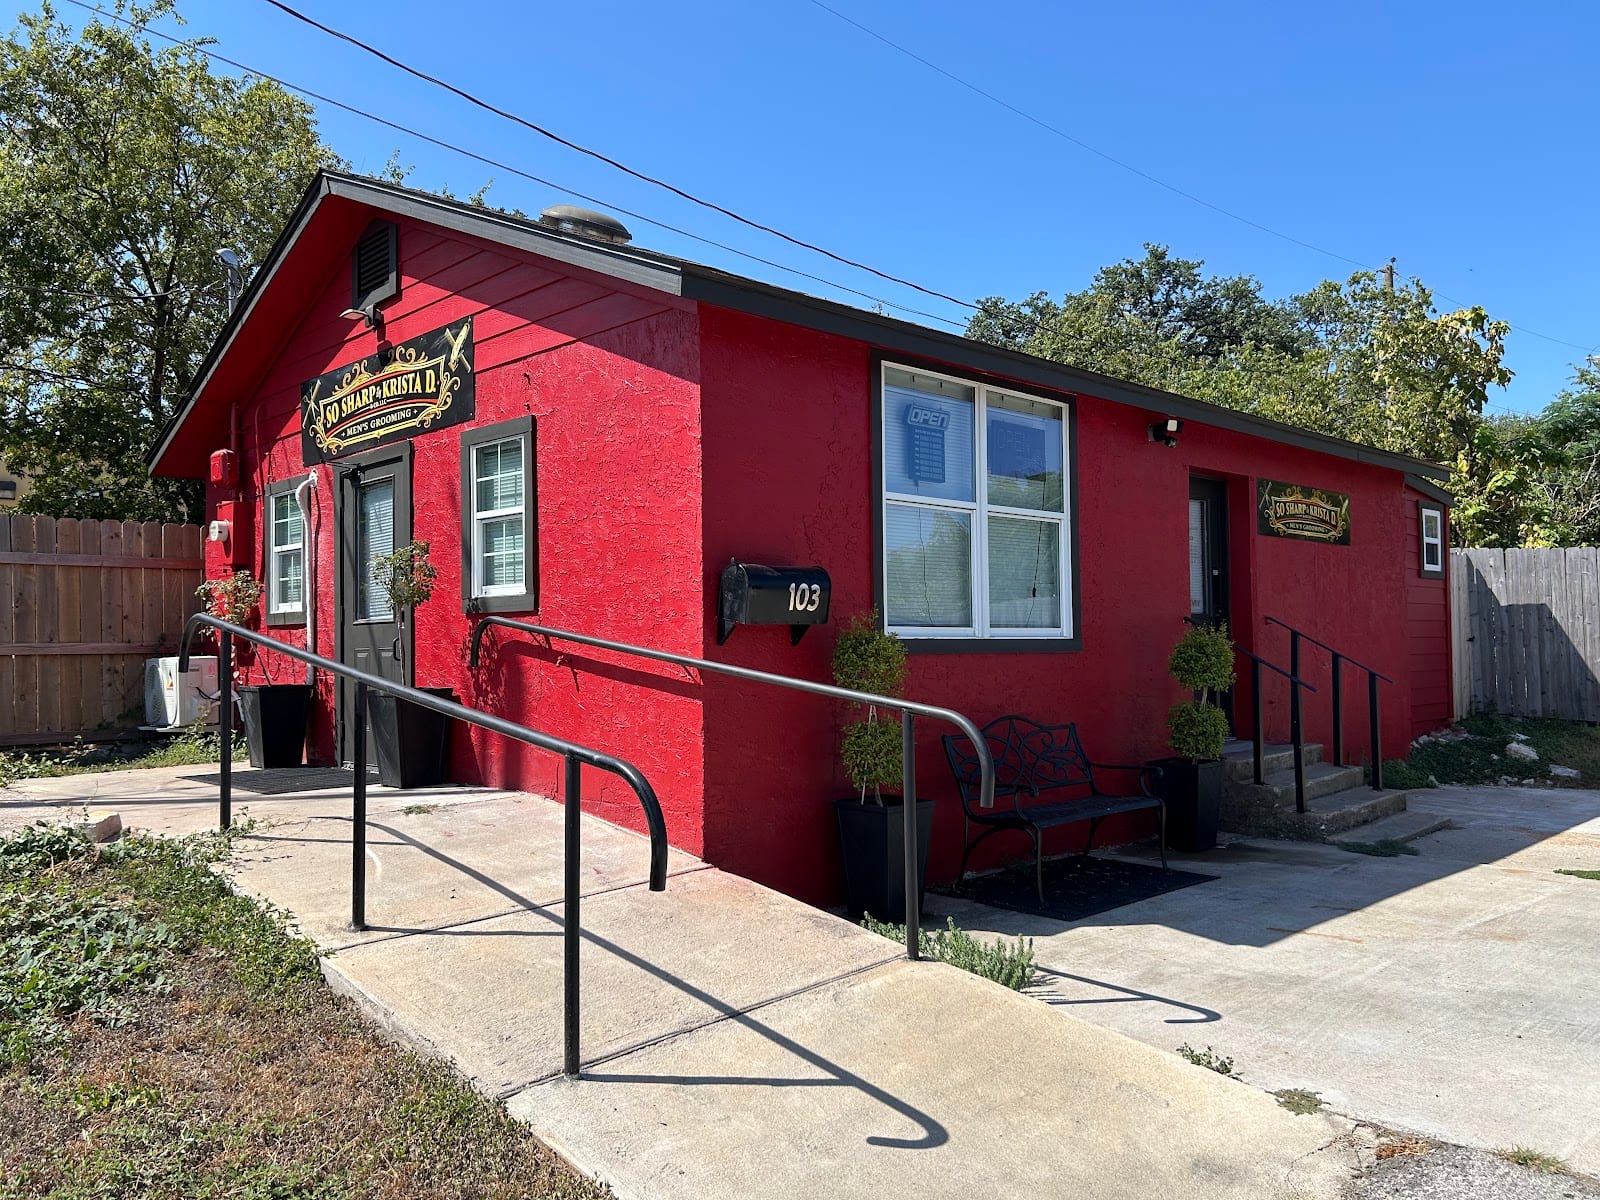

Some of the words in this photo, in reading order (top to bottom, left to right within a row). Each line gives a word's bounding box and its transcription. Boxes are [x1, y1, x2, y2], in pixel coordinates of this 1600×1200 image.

[326, 402, 339, 428] SO
[341, 385, 376, 417] SHARP
[382, 371, 422, 398] KRISTA
[425, 369, 436, 393] D.
[346, 422, 368, 436] MEN'S
[370, 409, 411, 428] GROOMING
[911, 408, 948, 428] OPEN
[1276, 503, 1285, 517] SO
[1286, 503, 1306, 515] SHARP
[1310, 505, 1330, 522] KRISTA
[789, 583, 820, 611] 103
